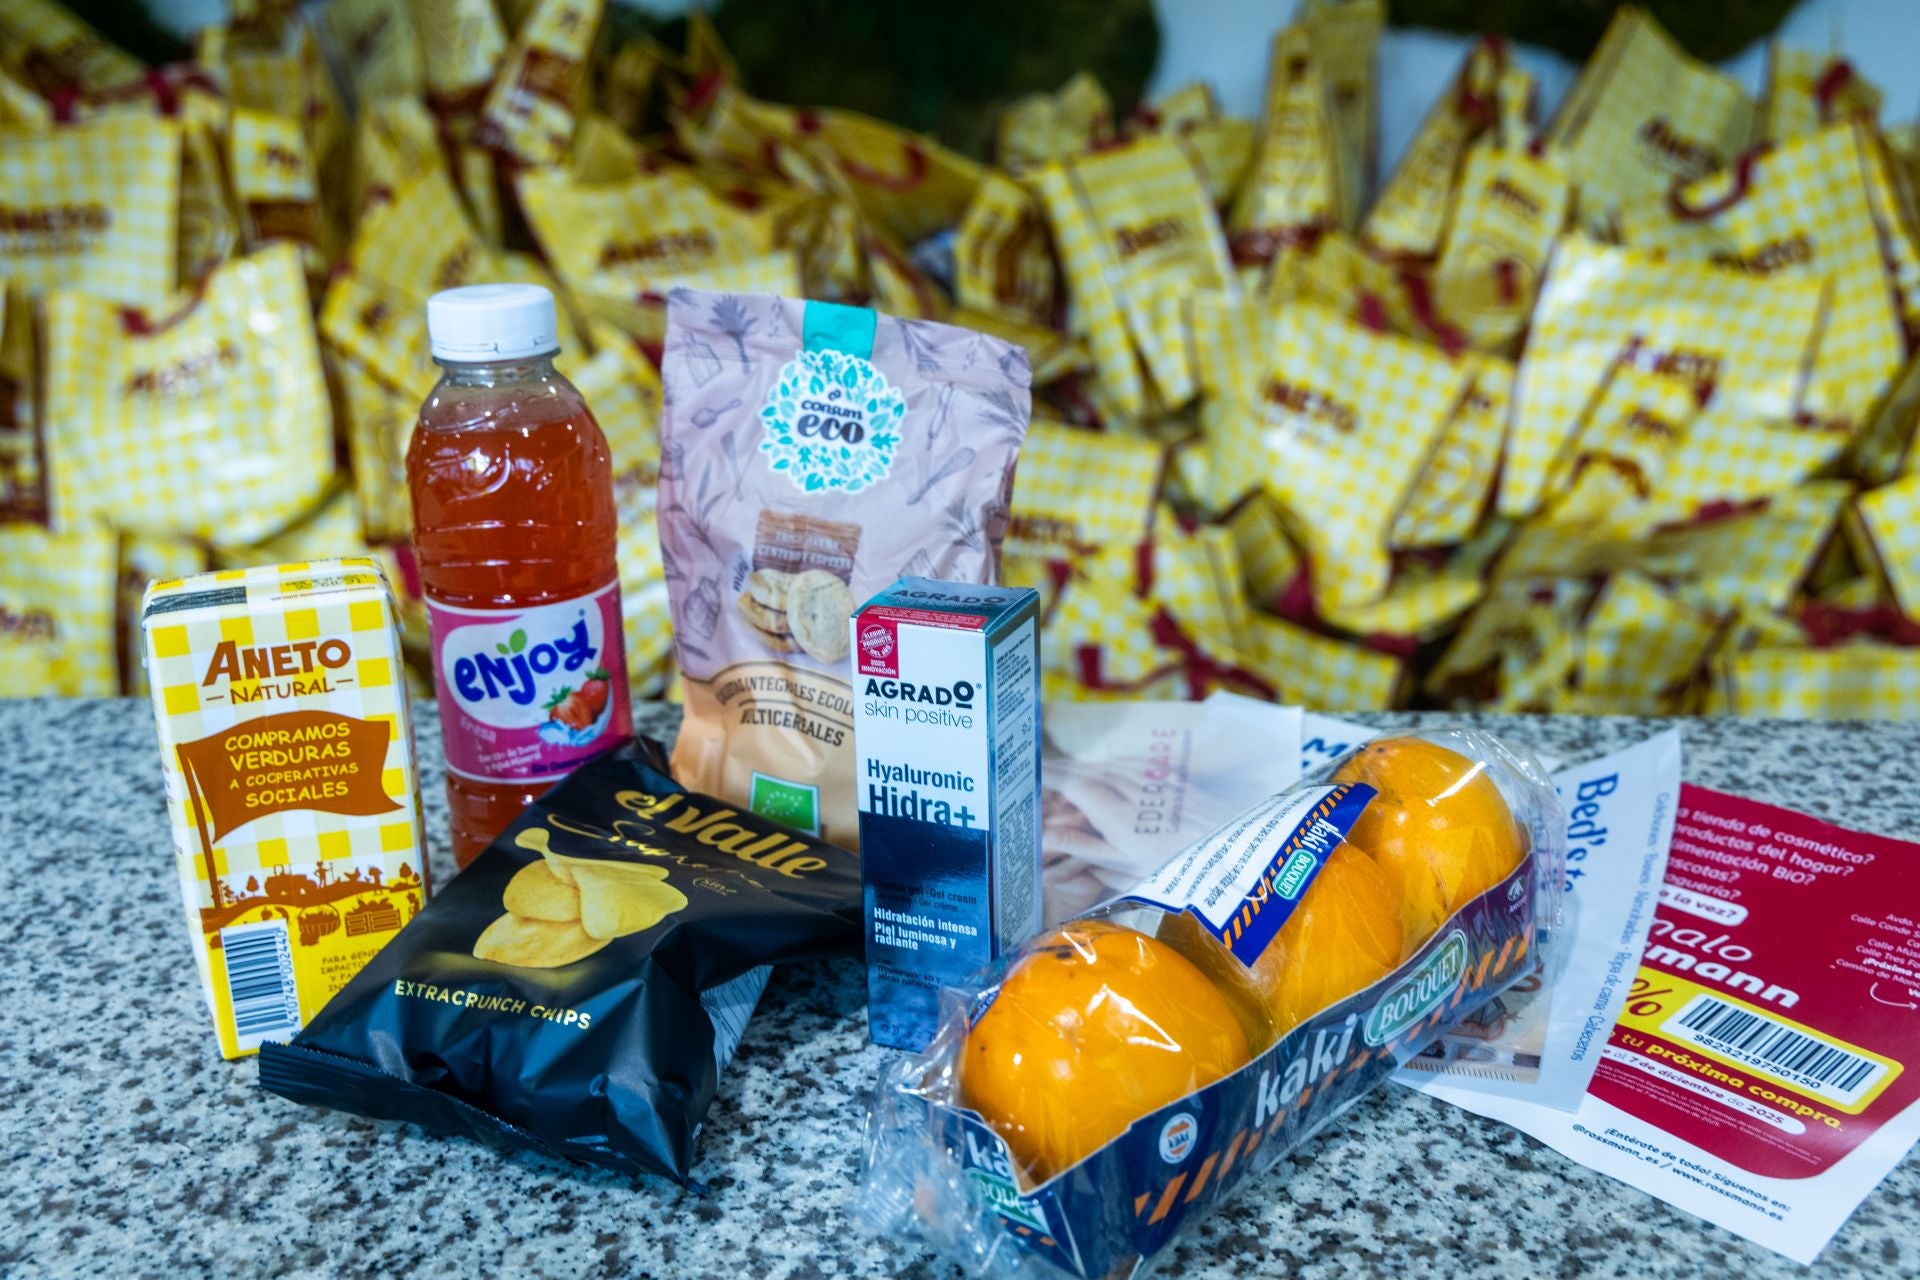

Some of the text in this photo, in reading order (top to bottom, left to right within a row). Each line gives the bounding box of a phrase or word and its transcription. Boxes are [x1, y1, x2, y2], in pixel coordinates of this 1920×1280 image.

[801, 400, 863, 421] consum
[797, 413, 865, 444] eco
[891, 590, 1006, 605] AGRADO
[863, 635, 892, 647] PRODUCTO
[202, 639, 351, 687] ANETO
[231, 677, 335, 704] NATURAL
[865, 677, 975, 709] AGRADO
[865, 700, 973, 729] skin positive
[225, 722, 350, 751] COMPRAMOS
[230, 741, 351, 771] VERDURAS
[230, 778, 240, 790] A
[867, 758, 974, 793] Hyaluronic
[245, 781, 349, 808] SOCIALES
[869, 783, 976, 828] Hidra+
[615, 789, 828, 880] el Valle
[1692, 810, 1746, 832] tienda
[1749, 824, 1771, 838] de
[1774, 831, 1875, 865] cosmética?
[1279, 818, 1348, 896] kaki BOUQUET
[1757, 843, 1787, 861] del
[1789, 850, 1854, 877] hogar?
[1674, 893, 1692, 905] la
[1696, 901, 1737, 919] vez?
[1851, 914, 1876, 926] Calle
[873, 907, 978, 937] Hidratación intensa
[874, 922, 957, 950] Piel luminosa y
[875, 933, 918, 950] radiante
[1856, 945, 1882, 957] Calle
[1868, 938, 1894, 951] Calle
[1613, 951, 1632, 977] Ropa
[1644, 941, 1800, 1009] mann
[1836, 958, 1875, 974] Camino
[395, 979, 592, 1031] EXTRACRUNCH CHIPS
[1255, 946, 1461, 1128] kaki BOUQUET
[1570, 1014, 1606, 1062] Cabeceros
[1694, 1034, 1821, 1089] 9823219750150
[1622, 1034, 1645, 1047] tu
[1646, 1044, 1744, 1088] próxima
[1749, 1085, 1844, 1131] compra.
[1639, 1062, 1655, 1071] de
[1658, 1068, 1724, 1098] diciembre
[1727, 1096, 1745, 1107] de
[1747, 1104, 1784, 1124] 2025
[1573, 1124, 1659, 1165] @rossmann_es
[1672, 1167, 1784, 1221] www.rossmann.es
[1604, 1128, 1660, 1153] ¡Entérate
[1661, 1152, 1676, 1160] de
[1679, 1158, 1711, 1176] todo!
[1771, 1200, 1791, 1212] en:
